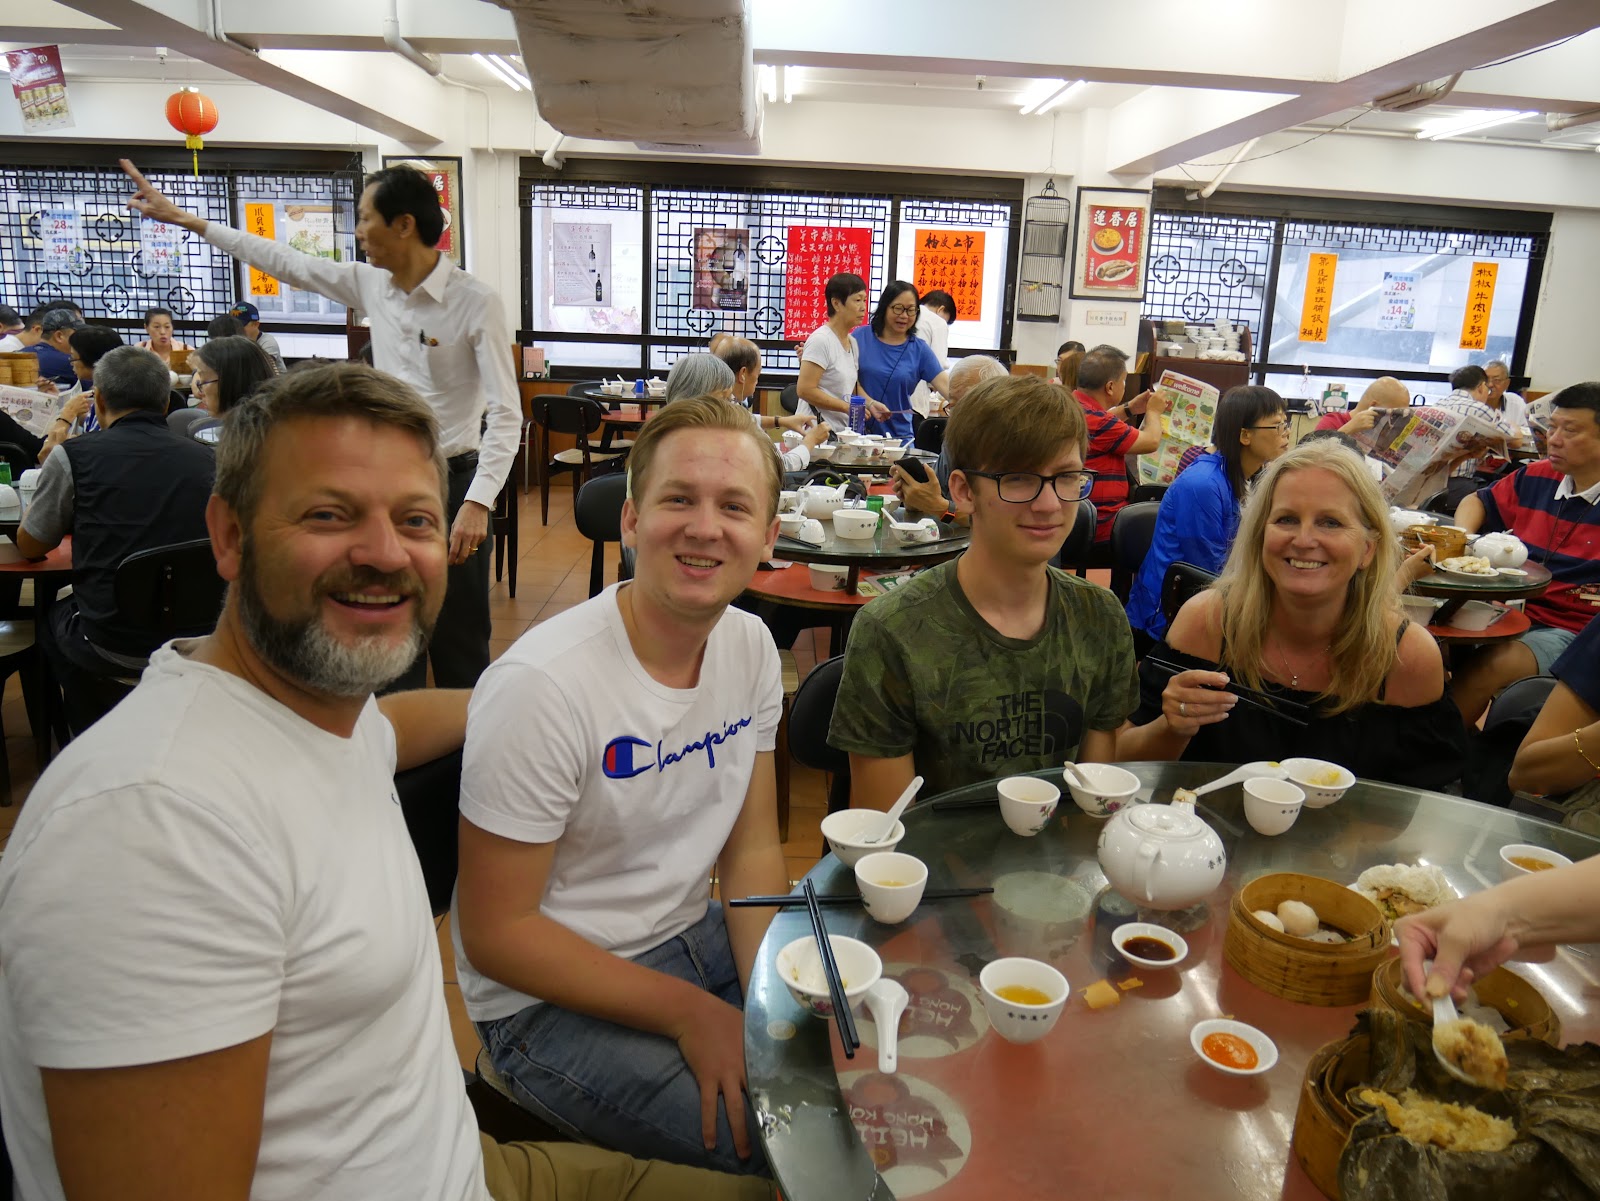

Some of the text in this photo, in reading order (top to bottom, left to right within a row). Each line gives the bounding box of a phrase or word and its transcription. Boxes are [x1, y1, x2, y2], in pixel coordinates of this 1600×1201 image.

[1093, 209, 1138, 228] 蓮香居
[924, 232, 975, 254] 柚皮上市
[1173, 383, 1200, 396] wellcome
[996, 690, 1043, 718] THE
[955, 713, 1043, 746] NORTH
[602, 716, 752, 779] Champion
[981, 734, 1042, 764] FACE
